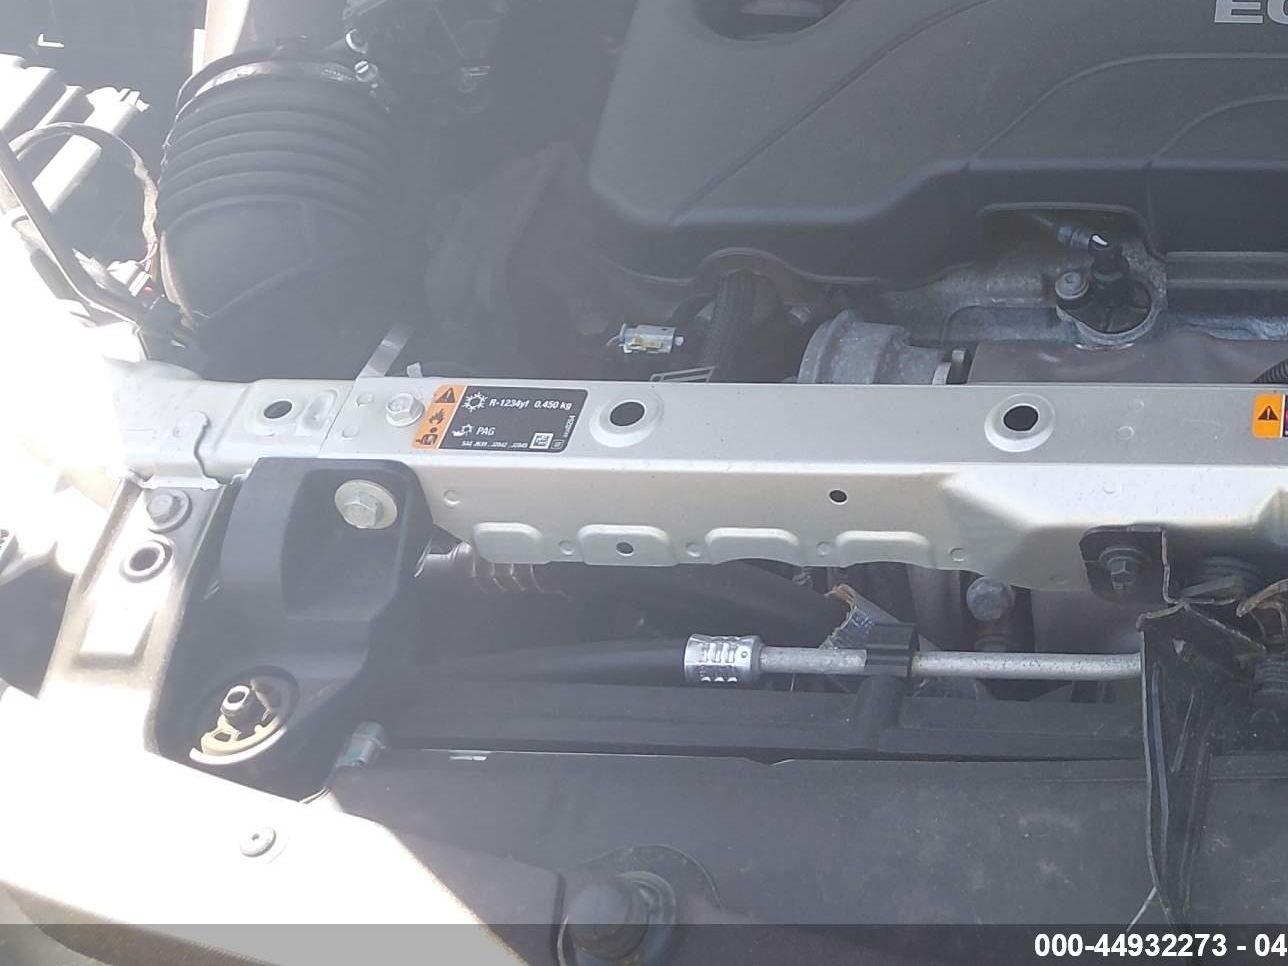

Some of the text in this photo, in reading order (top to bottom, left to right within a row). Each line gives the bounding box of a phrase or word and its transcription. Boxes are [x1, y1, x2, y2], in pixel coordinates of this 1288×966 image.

[488, 398, 573, 411] R-1234yf 0.450 kg
[476, 426, 496, 436] PAG
